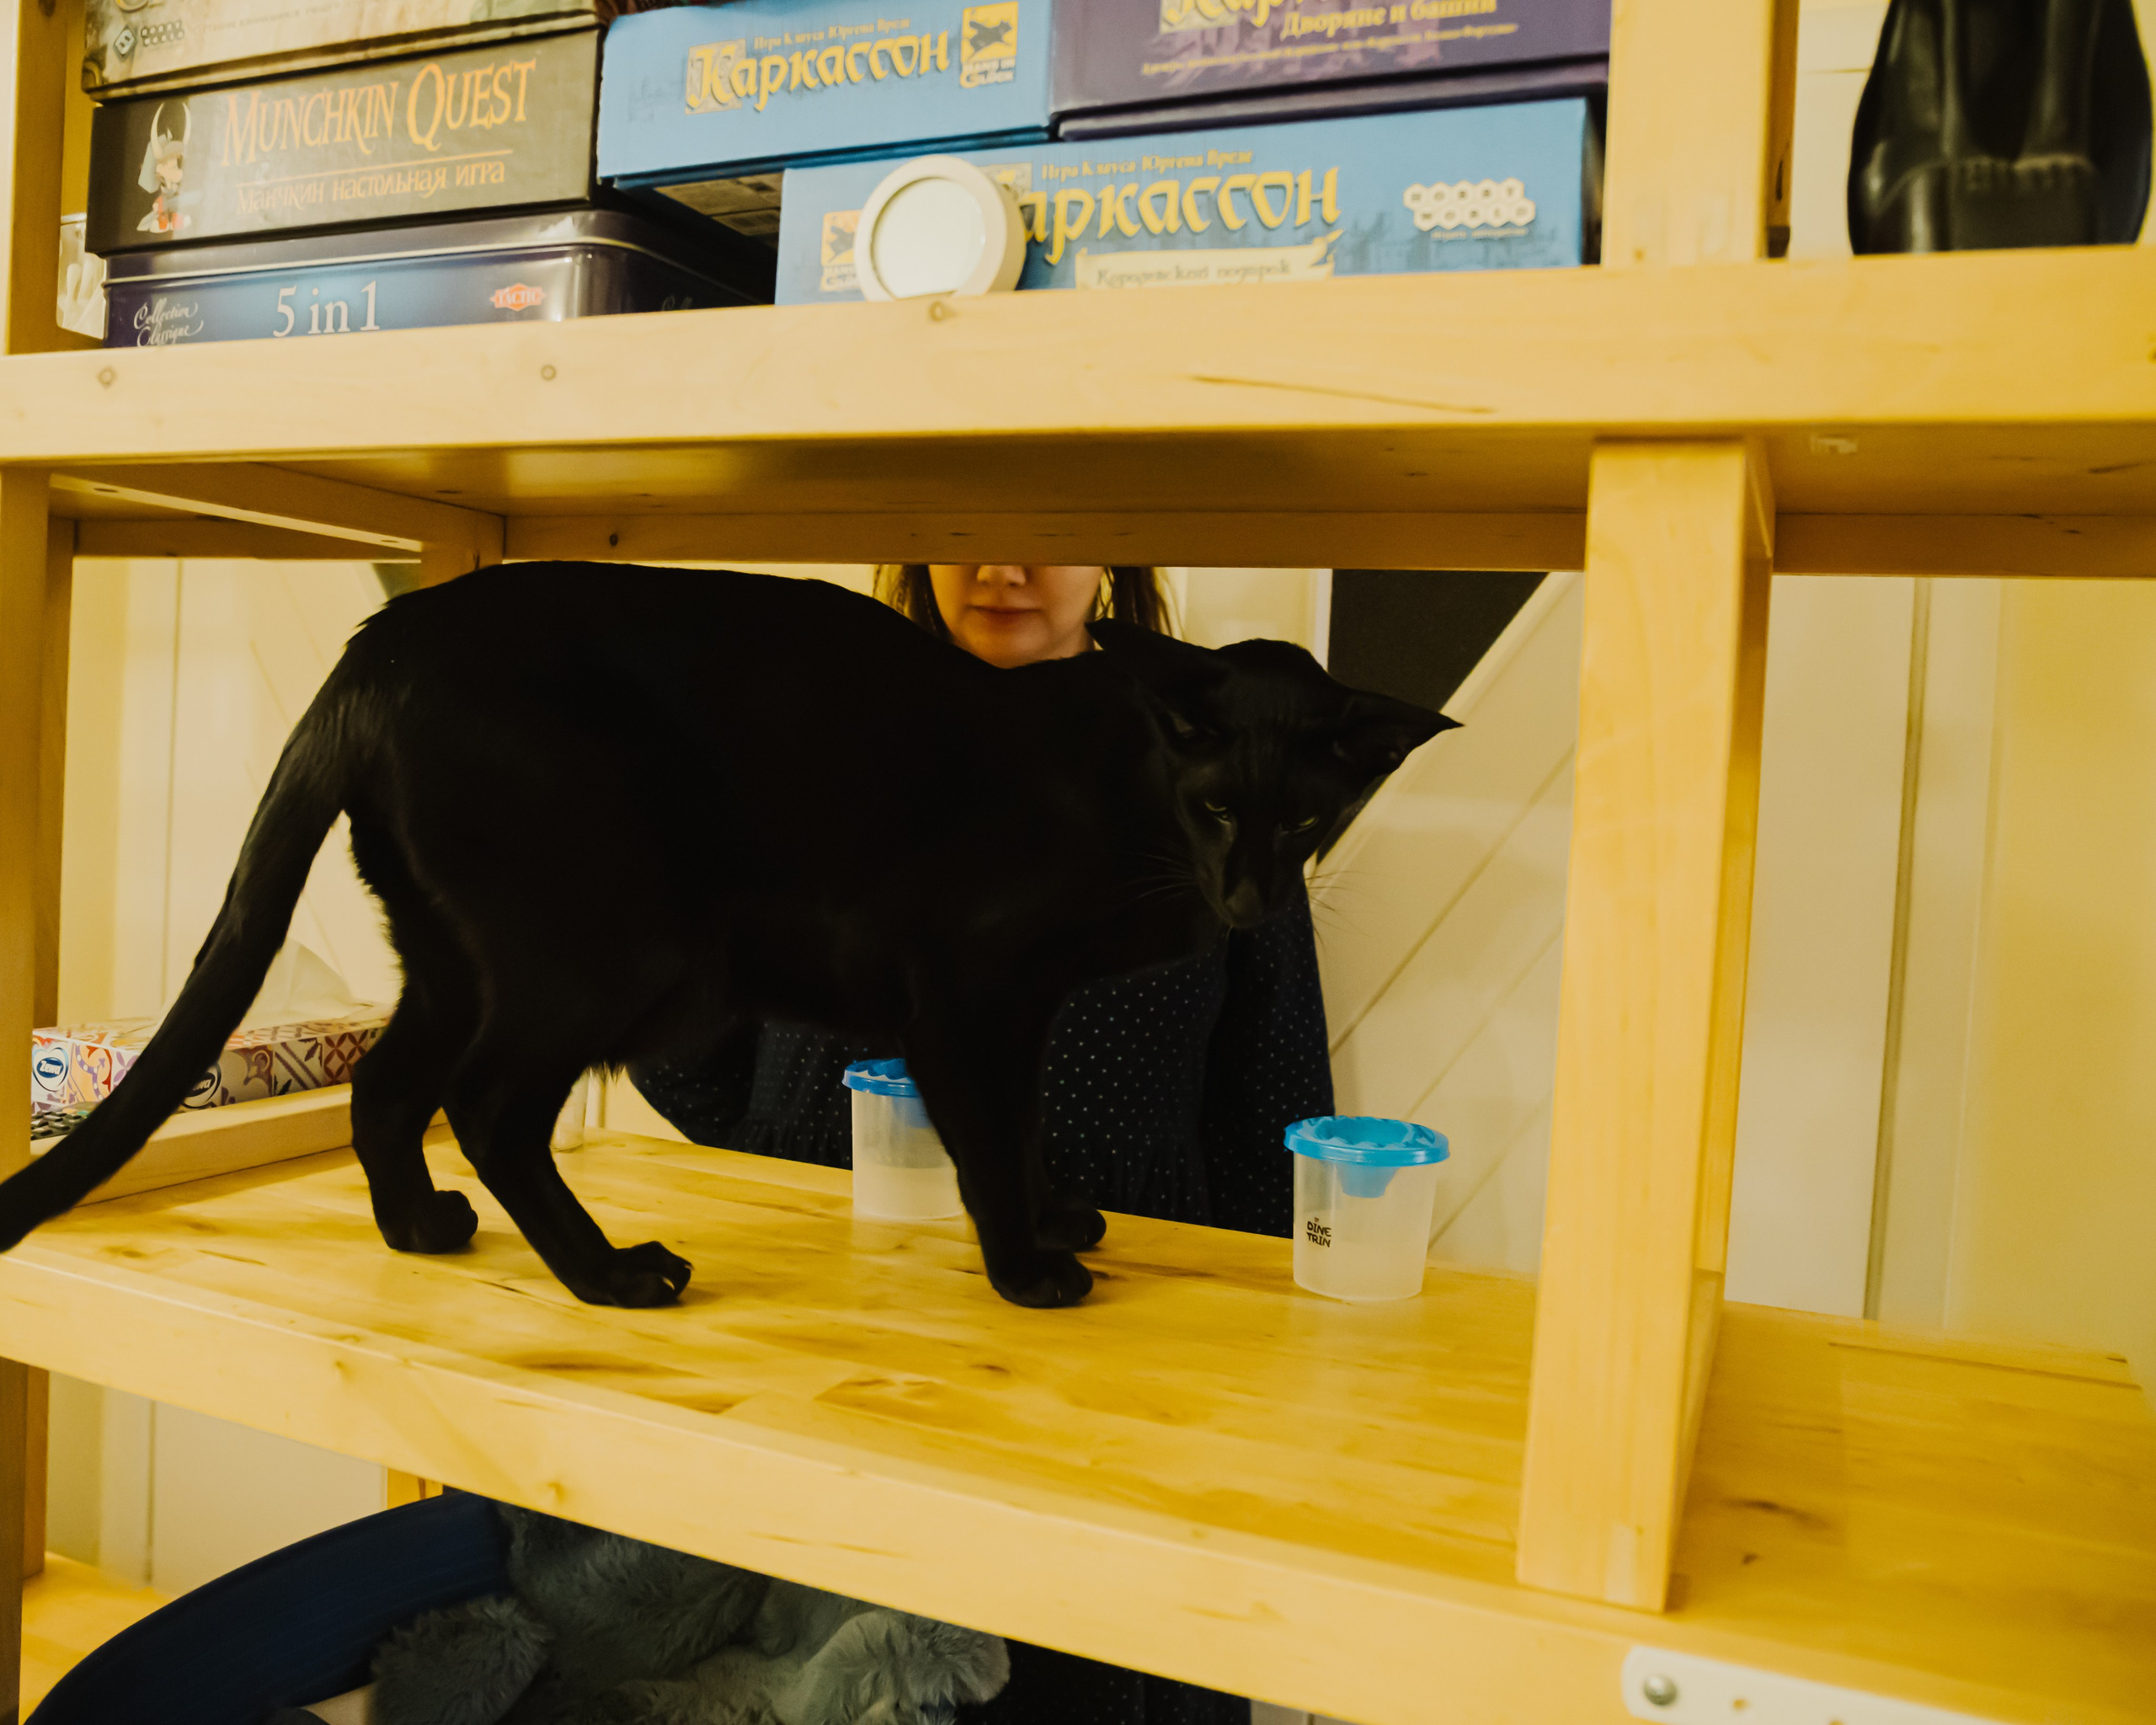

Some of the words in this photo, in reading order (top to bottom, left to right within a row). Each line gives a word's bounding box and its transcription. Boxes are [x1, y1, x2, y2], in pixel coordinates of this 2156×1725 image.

[686, 29, 950, 113] Каркассон
[1004, 166, 1342, 266] аркассон
[133, 297, 199, 330] Collection
[272, 284, 298, 338] 5
[307, 287, 351, 334] in
[360, 280, 380, 332] 1
[39, 1060, 64, 1076] Zewa
[1306, 1220, 1332, 1237] DINE
[1306, 1231, 1331, 1248] TRIN
